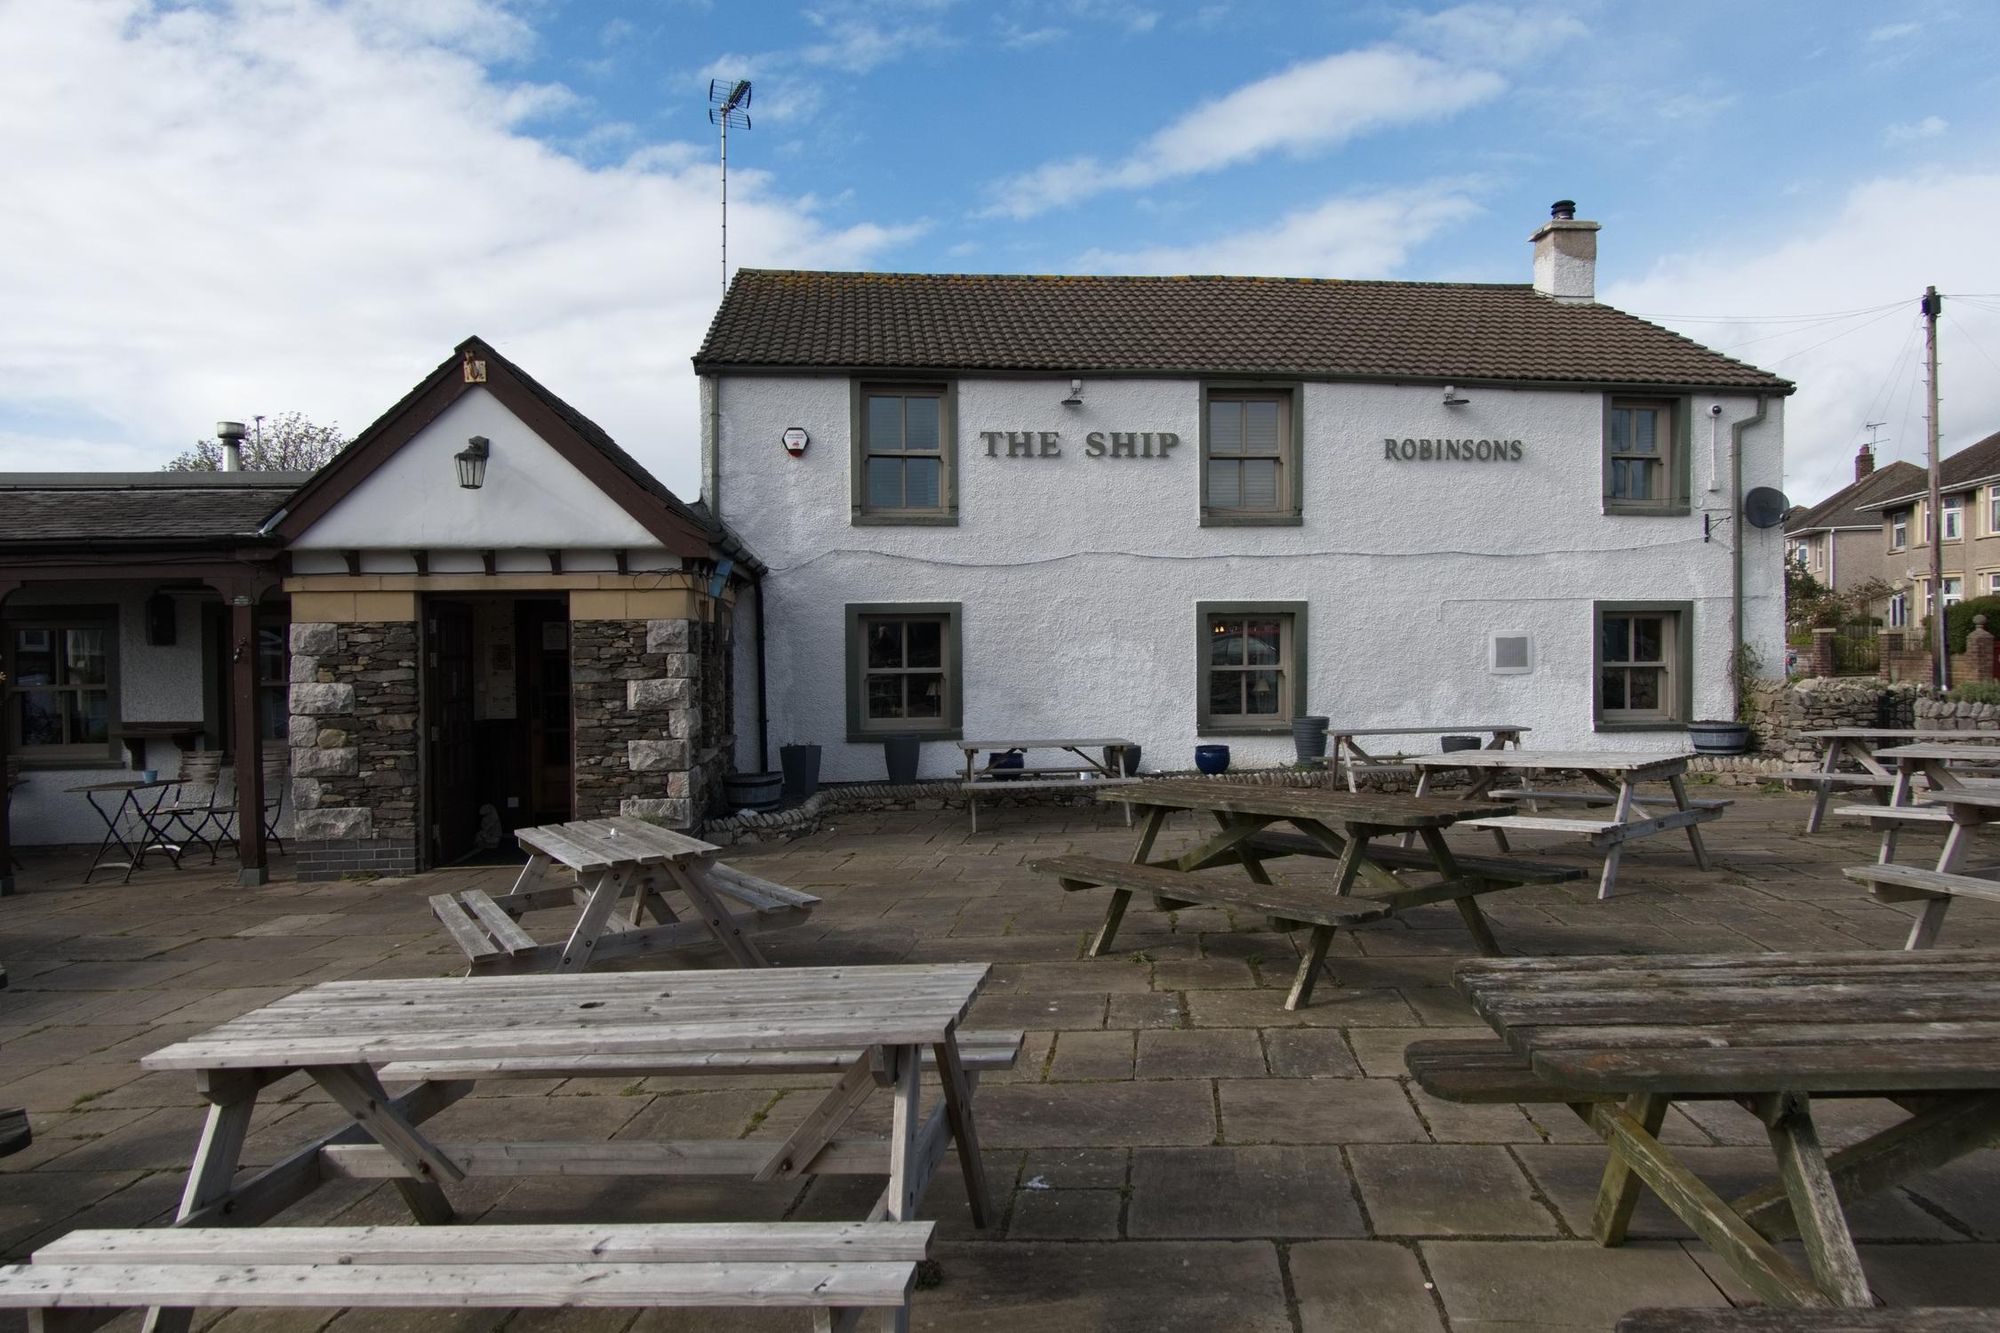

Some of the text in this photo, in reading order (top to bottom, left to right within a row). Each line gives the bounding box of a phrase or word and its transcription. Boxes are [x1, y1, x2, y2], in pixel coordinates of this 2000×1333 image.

[980, 431, 1180, 457] THE SHIP
[1384, 438, 1523, 461] ROBINSONS
